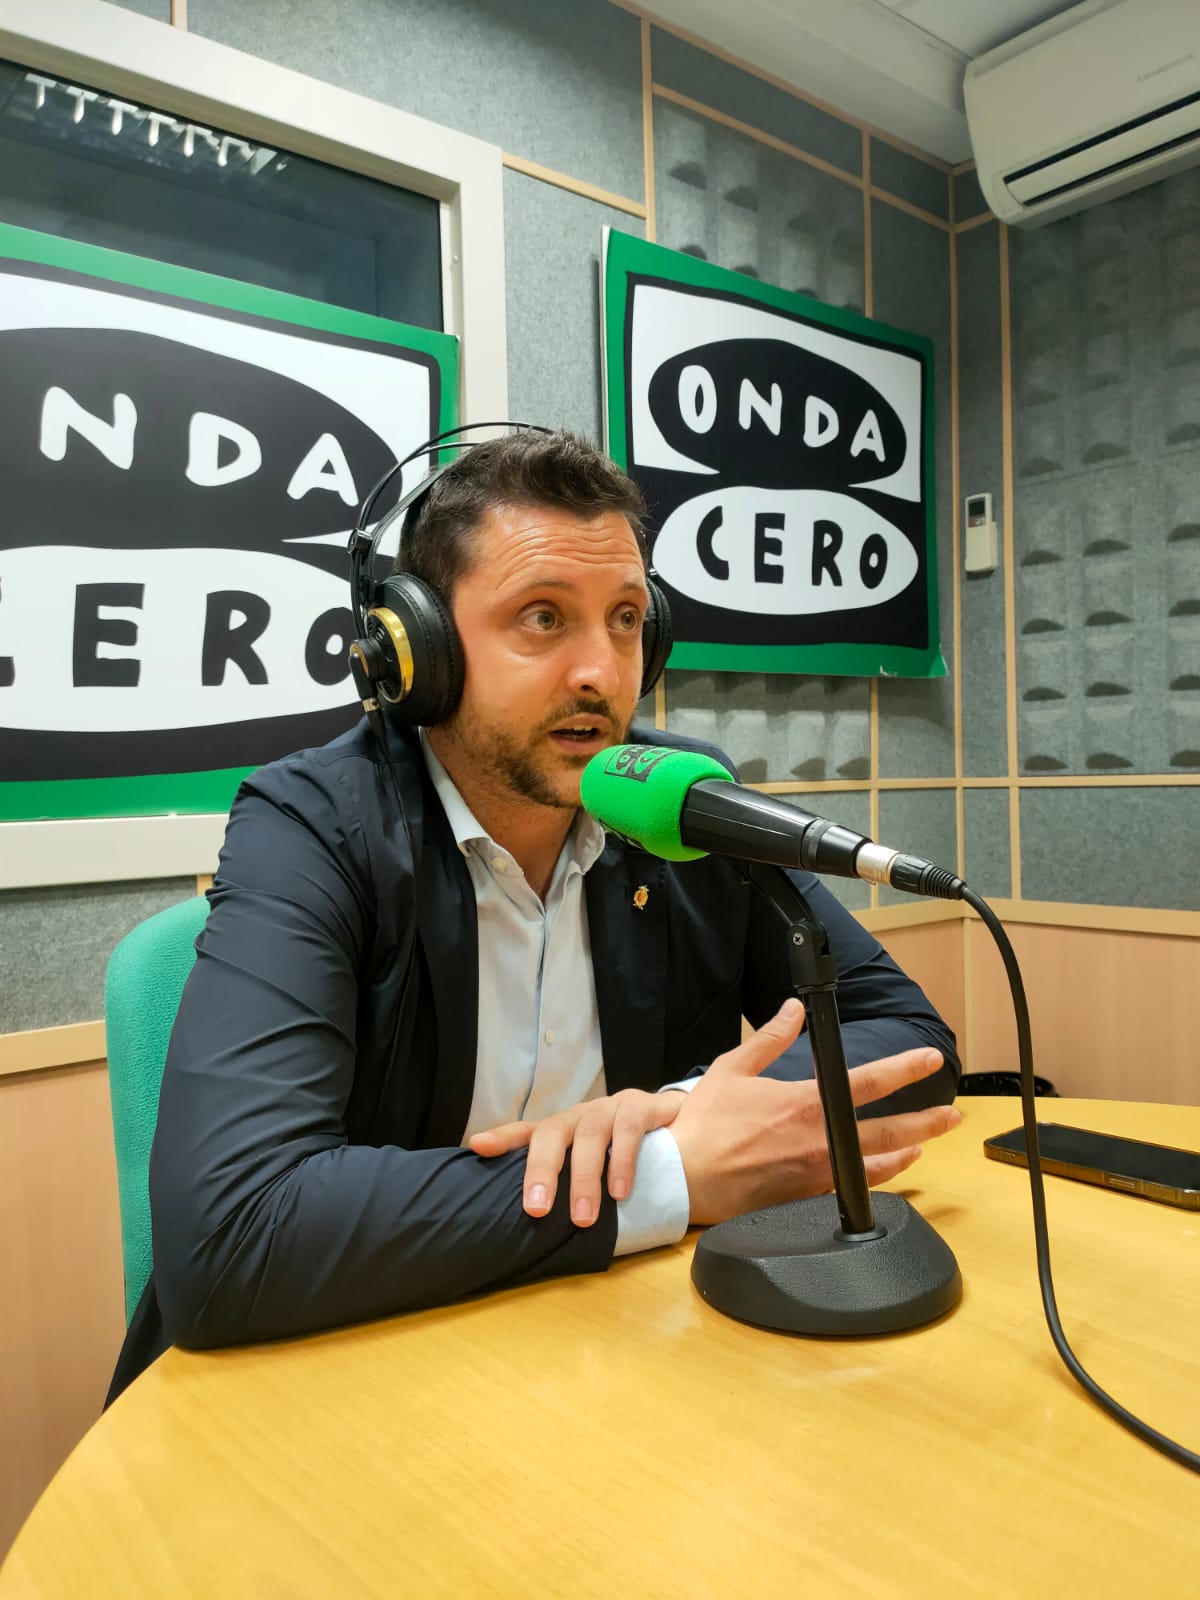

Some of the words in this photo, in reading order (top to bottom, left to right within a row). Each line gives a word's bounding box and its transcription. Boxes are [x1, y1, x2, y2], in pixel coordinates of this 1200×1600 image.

[678, 364, 886, 462] ONDA
[696, 505, 889, 589] CERO
[0, 576, 354, 687] ERO
